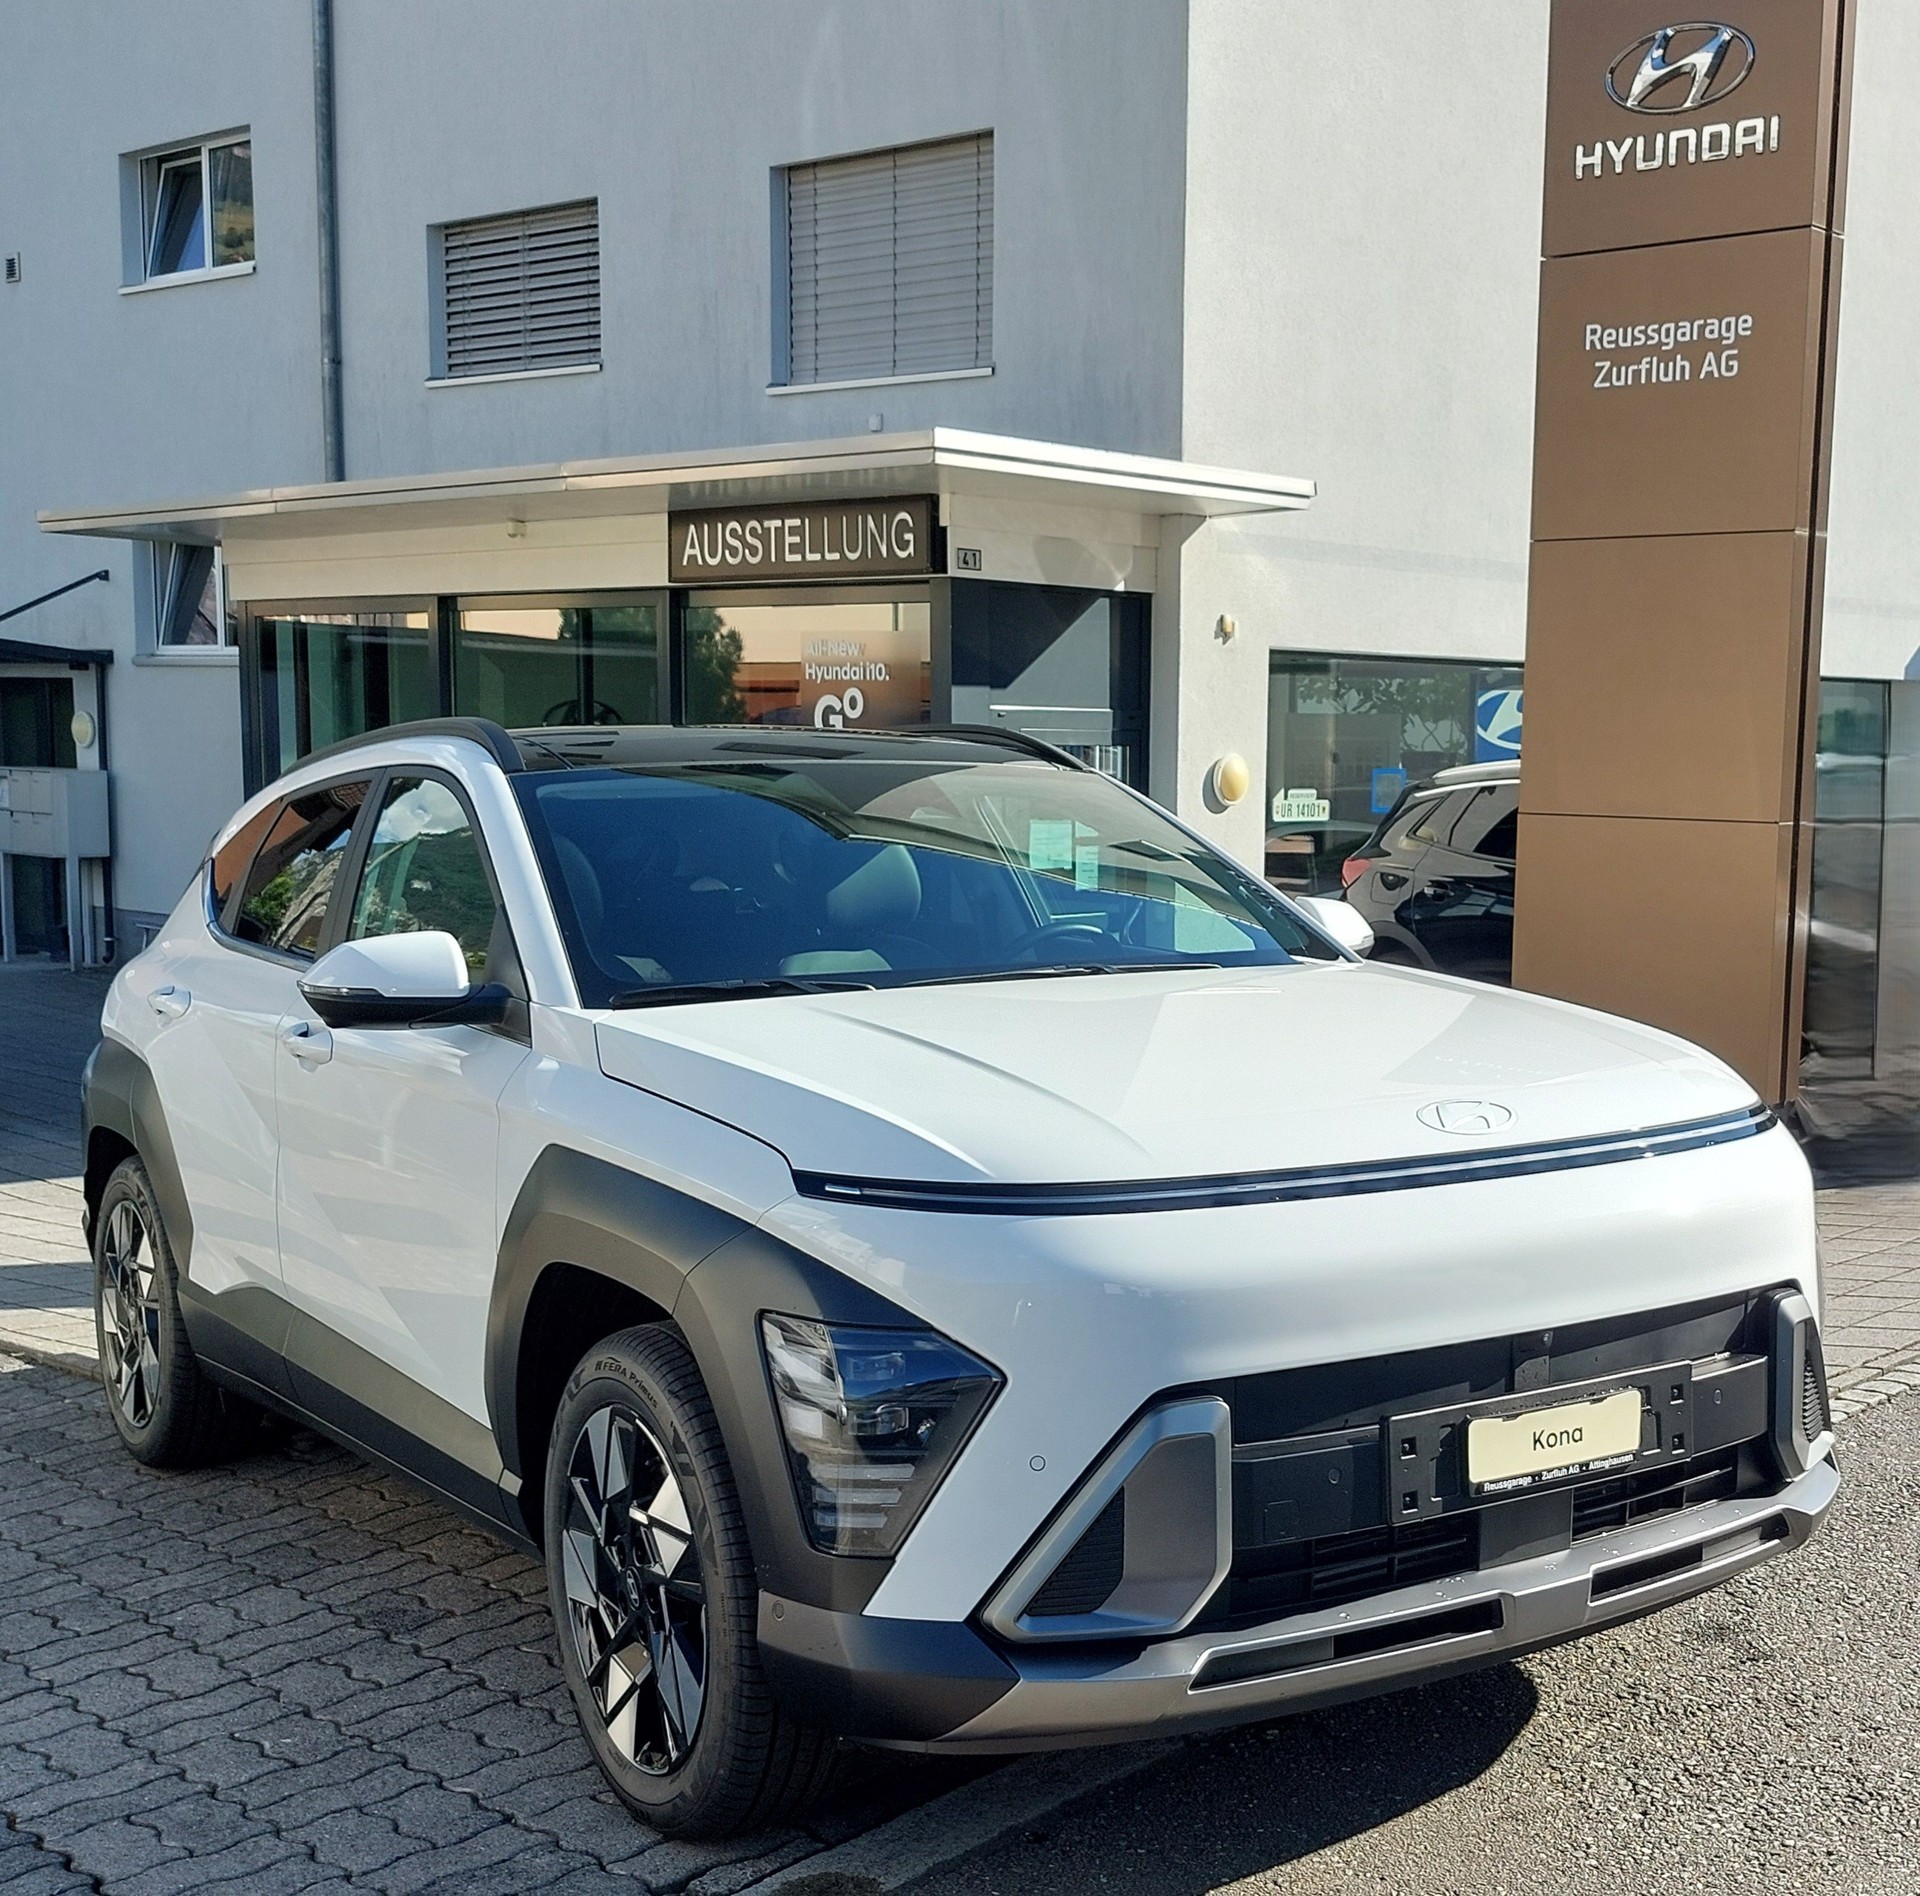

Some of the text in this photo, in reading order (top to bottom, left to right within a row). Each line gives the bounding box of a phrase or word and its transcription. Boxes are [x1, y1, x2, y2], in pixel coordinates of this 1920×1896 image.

[1575, 114, 1780, 180] HYUNDAI
[1585, 314, 1753, 351] Reussgarage
[1594, 349, 1739, 389] Zurfluh AG
[682, 511, 915, 566] AUSSTELLUNG
[963, 551, 977, 568] 41
[805, 661, 890, 684] Hyundai i10.
[1280, 802, 1320, 818] UR 14101
[629, 1371, 659, 1409] Primus
[1533, 1426, 1583, 1451] Kona
[1483, 1474, 1533, 1493] Reussgarage
[1568, 1464, 1580, 1475] AG
